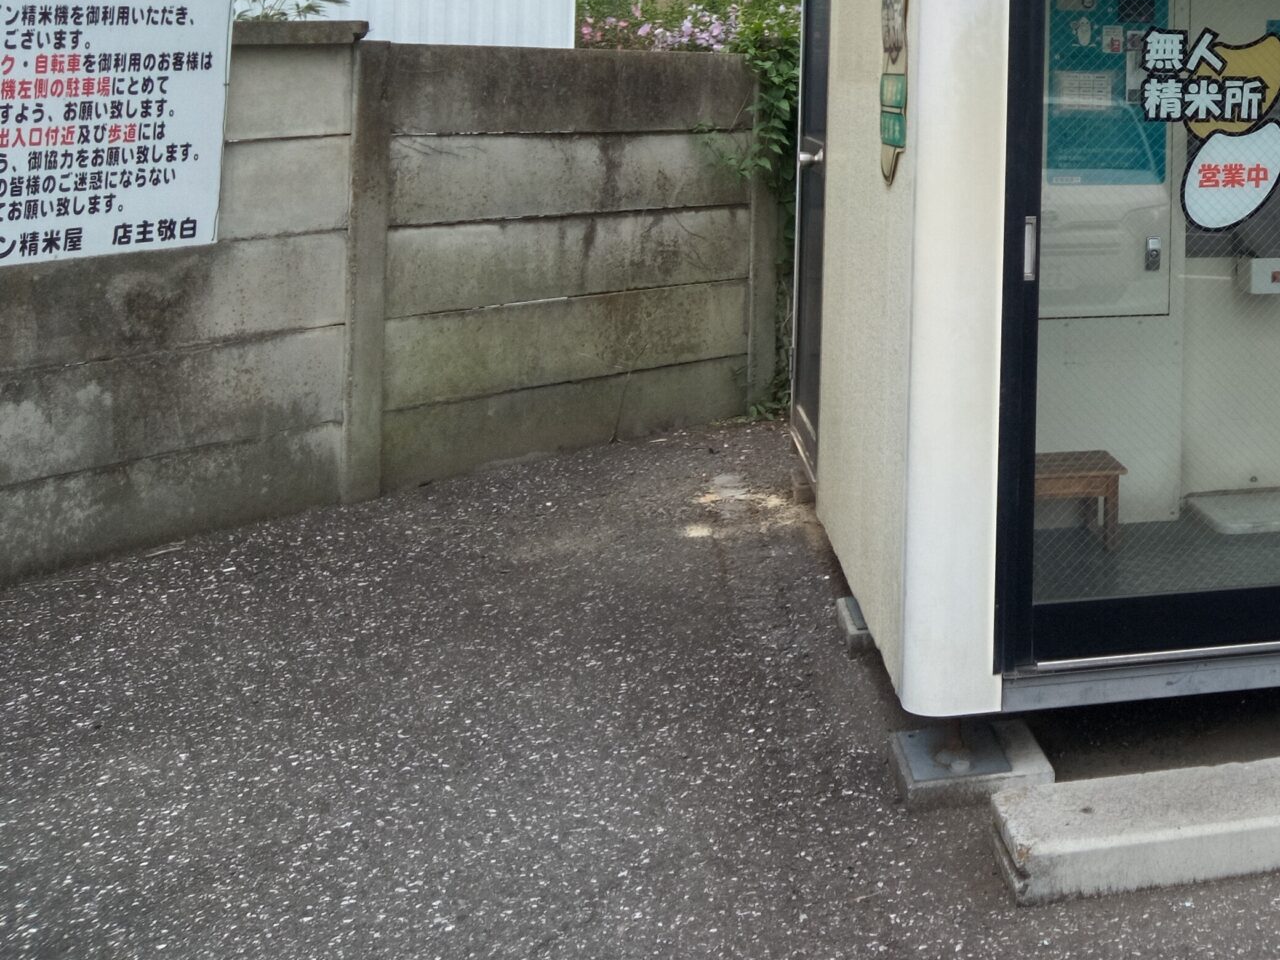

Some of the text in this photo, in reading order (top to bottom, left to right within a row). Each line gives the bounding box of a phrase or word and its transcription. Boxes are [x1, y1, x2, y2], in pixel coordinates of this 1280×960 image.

[0, 4, 194, 26] ン精米機を御利用いただき、
[4, 28, 91, 50] ございます。
[1142, 29, 1227, 73] 無人
[1, 51, 213, 76] ク・自転車を御利用のお客様は
[1, 76, 169, 101] 機左側の駐車場にとめて
[1143, 77, 1263, 120] 精米所
[0, 98, 175, 124] すよう、お願い致します。
[0, 121, 166, 148] 出入口付近及び歩道には
[0, 142, 199, 173] う、御協力をお願い致します。
[1198, 163, 1269, 189] 営業中
[112, 217, 197, 246] 店主敬白
